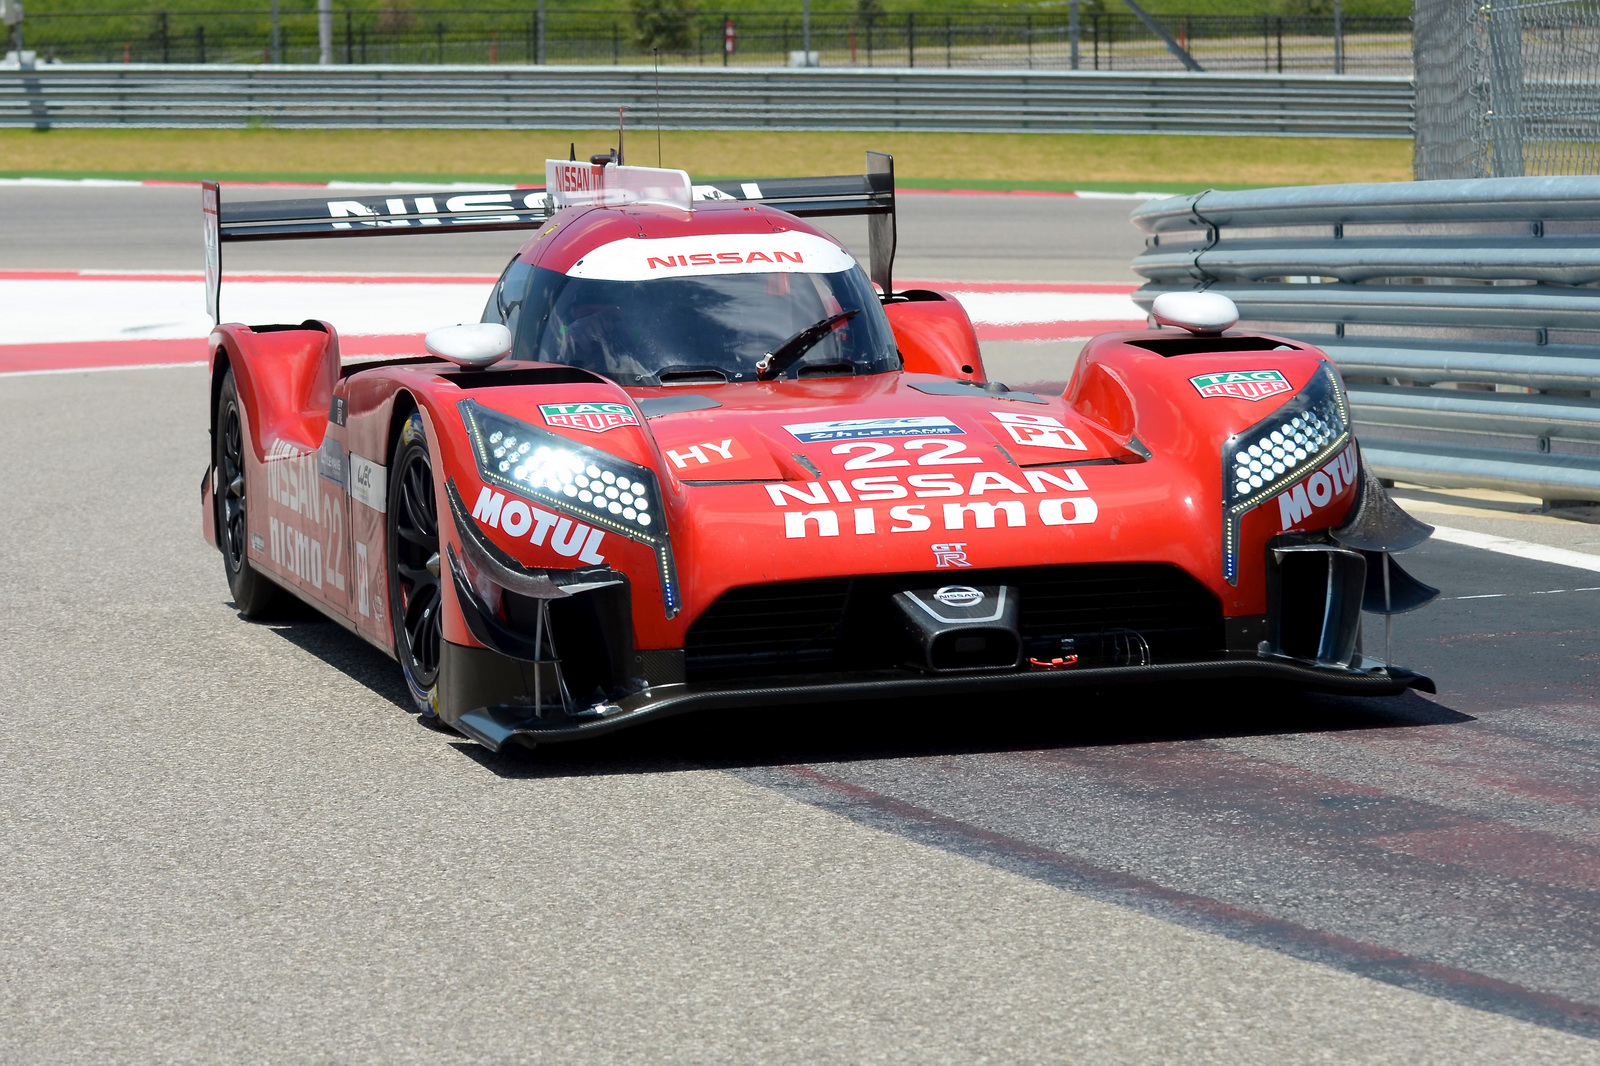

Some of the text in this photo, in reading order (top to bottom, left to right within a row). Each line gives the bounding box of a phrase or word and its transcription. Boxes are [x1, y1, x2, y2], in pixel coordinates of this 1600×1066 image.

[555, 166, 590, 192] NISSAN
[646, 251, 804, 269] NISSAN
[1199, 372, 1277, 384] TAG
[1205, 381, 1286, 398] HEUER
[548, 404, 628, 414] TAG
[552, 413, 636, 430] HEUER
[857, 429, 884, 437] LE
[1011, 425, 1076, 446] P1
[665, 438, 734, 469] HY
[830, 438, 984, 471] 22
[264, 437, 320, 524] NISSAN
[763, 468, 1090, 507] NISSAN
[471, 485, 606, 566] MOTUL
[783, 496, 1099, 539] nismo
[270, 516, 323, 590] nismo
[324, 493, 346, 592] 22
[931, 542, 968, 552] GT
[933, 551, 973, 568] R
[938, 592, 981, 600] NISSAN
